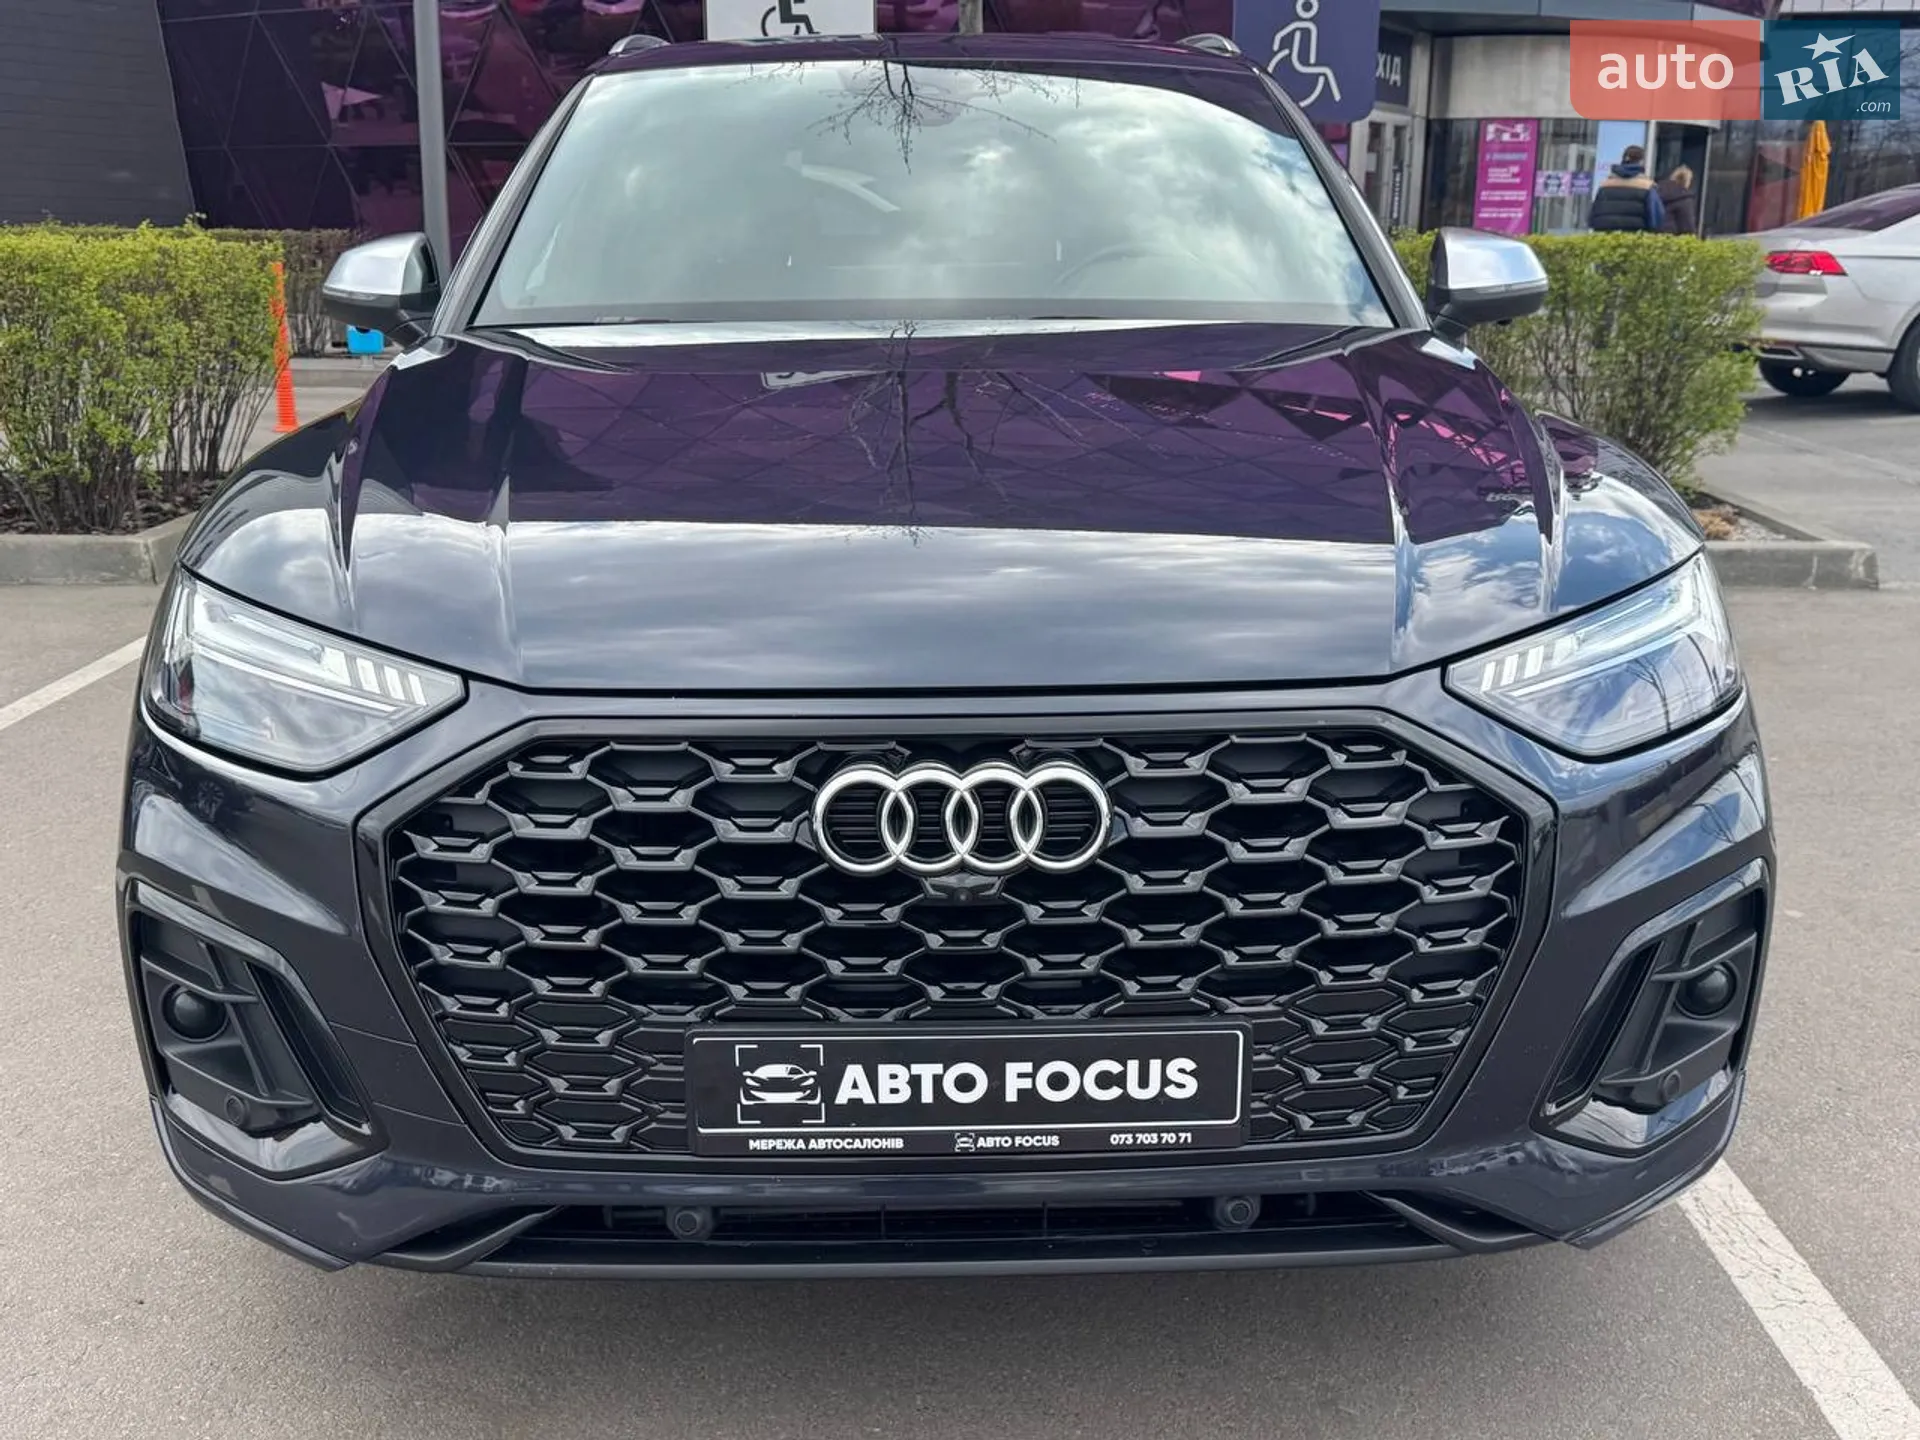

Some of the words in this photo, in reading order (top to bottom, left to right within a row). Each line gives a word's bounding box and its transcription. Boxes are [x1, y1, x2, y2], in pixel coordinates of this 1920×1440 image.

[1375, 52, 1402, 88] ХІД
[834, 1061, 988, 1105] АВТО
[1005, 1057, 1199, 1103] FOCUS
[749, 1138, 805, 1151] МЕРЕЖА
[808, 1137, 904, 1150] АВТОСАЛОНІВ
[977, 1135, 1012, 1149] АВТО
[1014, 1135, 1060, 1147] FOCUS
[1110, 1132, 1134, 1146] 073
[1136, 1132, 1159, 1145] 703
[1162, 1131, 1177, 1145] 70
[1179, 1131, 1192, 1144] 71
